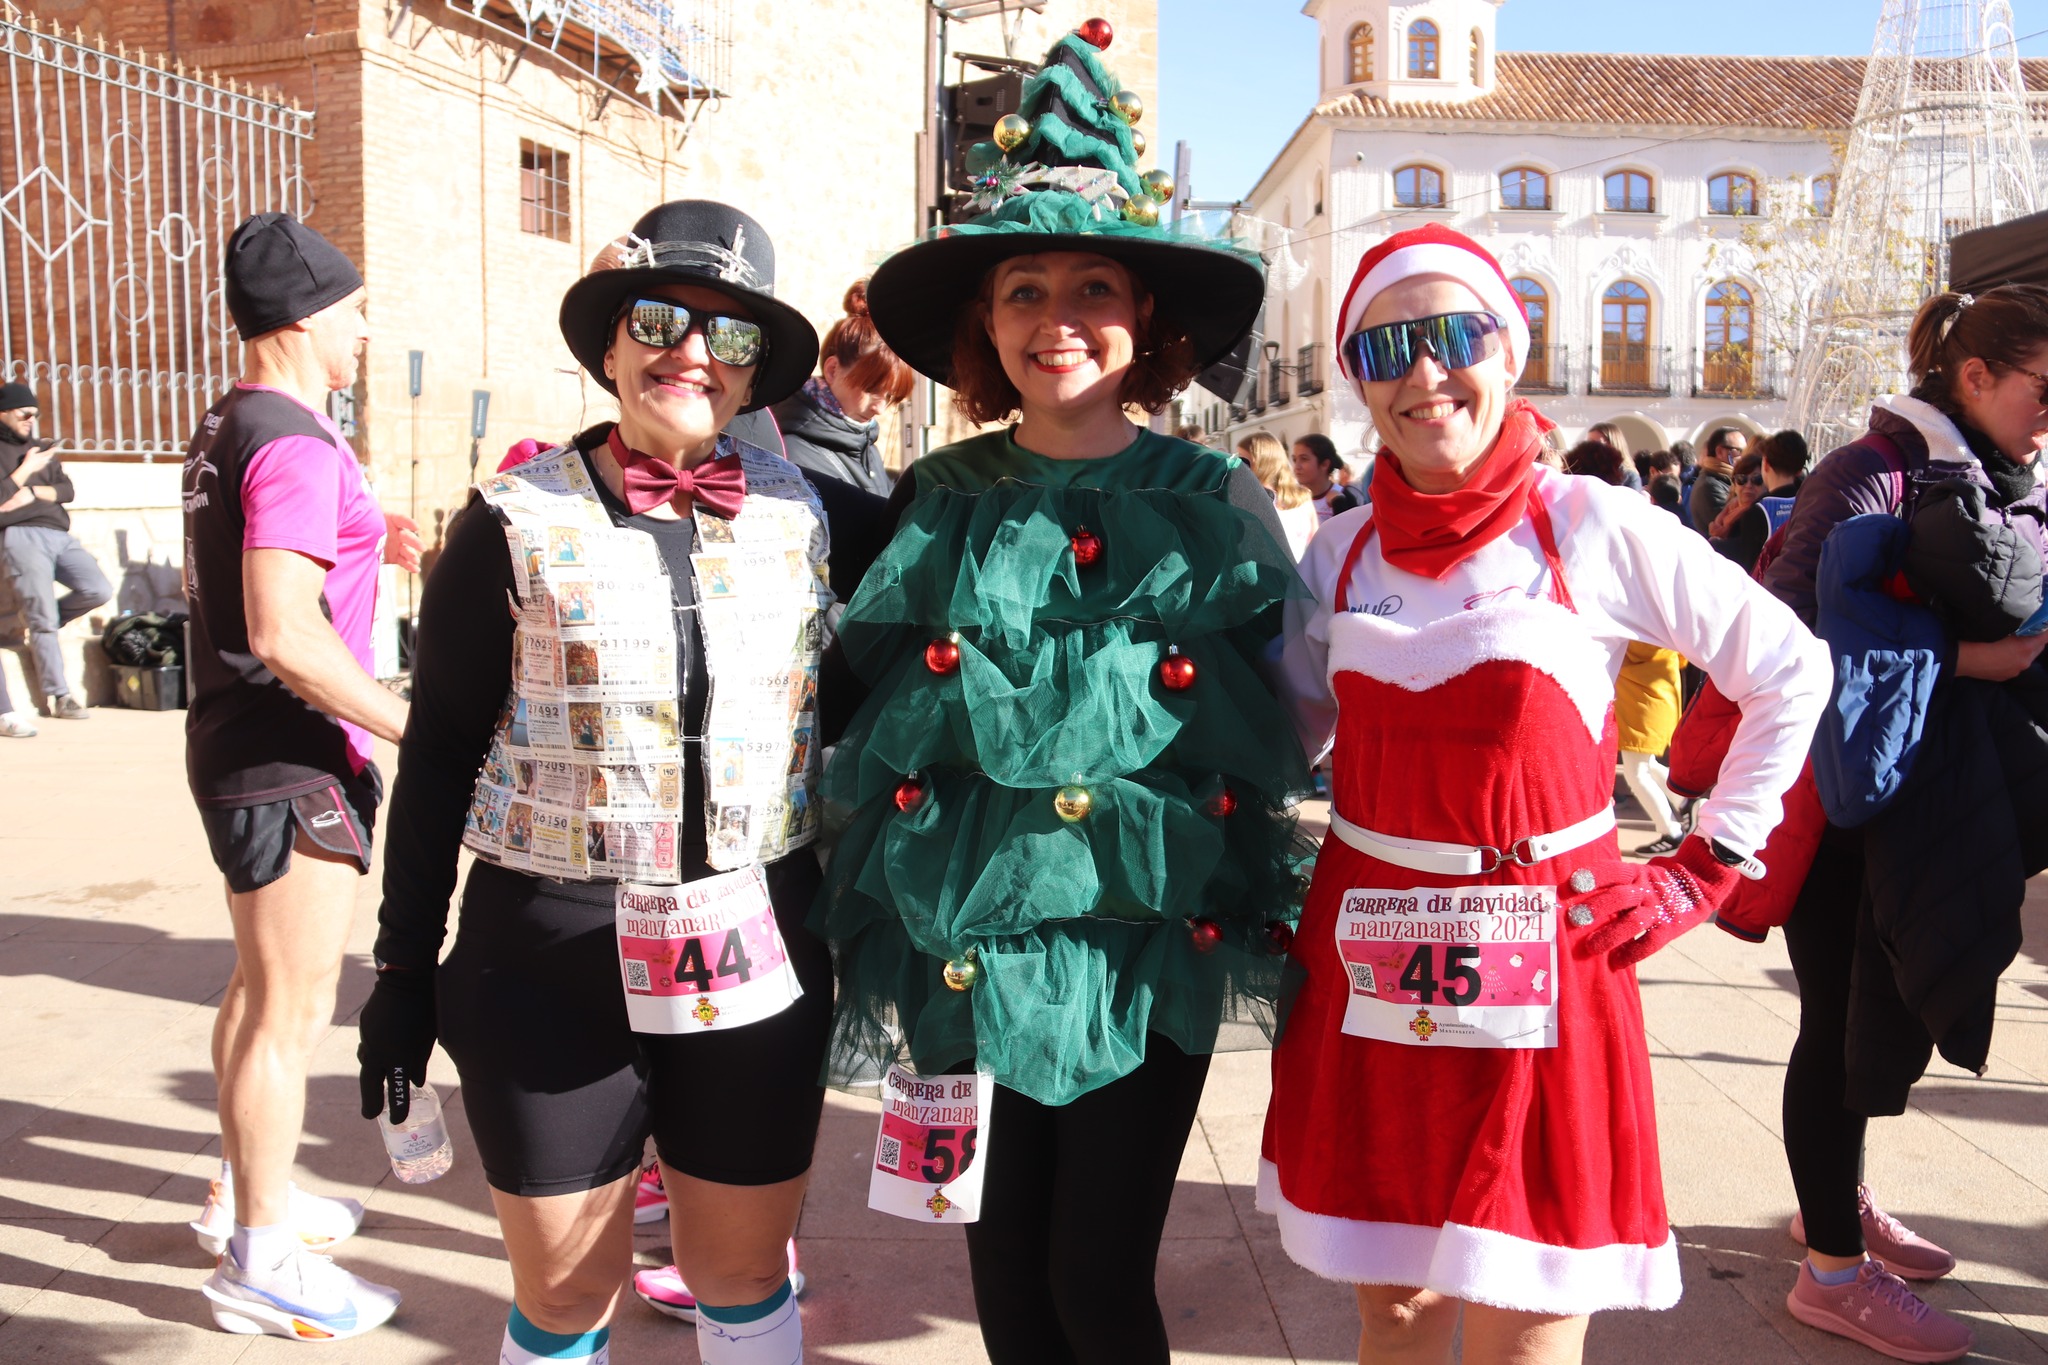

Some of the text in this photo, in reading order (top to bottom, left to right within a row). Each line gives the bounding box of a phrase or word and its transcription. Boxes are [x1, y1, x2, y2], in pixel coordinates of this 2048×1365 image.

[597, 580, 646, 593] 8029
[525, 636, 553, 652] 77625
[600, 638, 651, 650] 41199
[750, 676, 789, 686] 82568
[528, 703, 560, 718] 27492
[604, 706, 654, 718] 73995
[665, 795, 673, 803] 20
[533, 811, 568, 828] 06150
[1459, 892, 1546, 917] navidad
[1490, 915, 1545, 942] 2024
[674, 927, 753, 993] 44
[1399, 944, 1483, 1007] 45
[393, 1067, 404, 1106] KIPSTA
